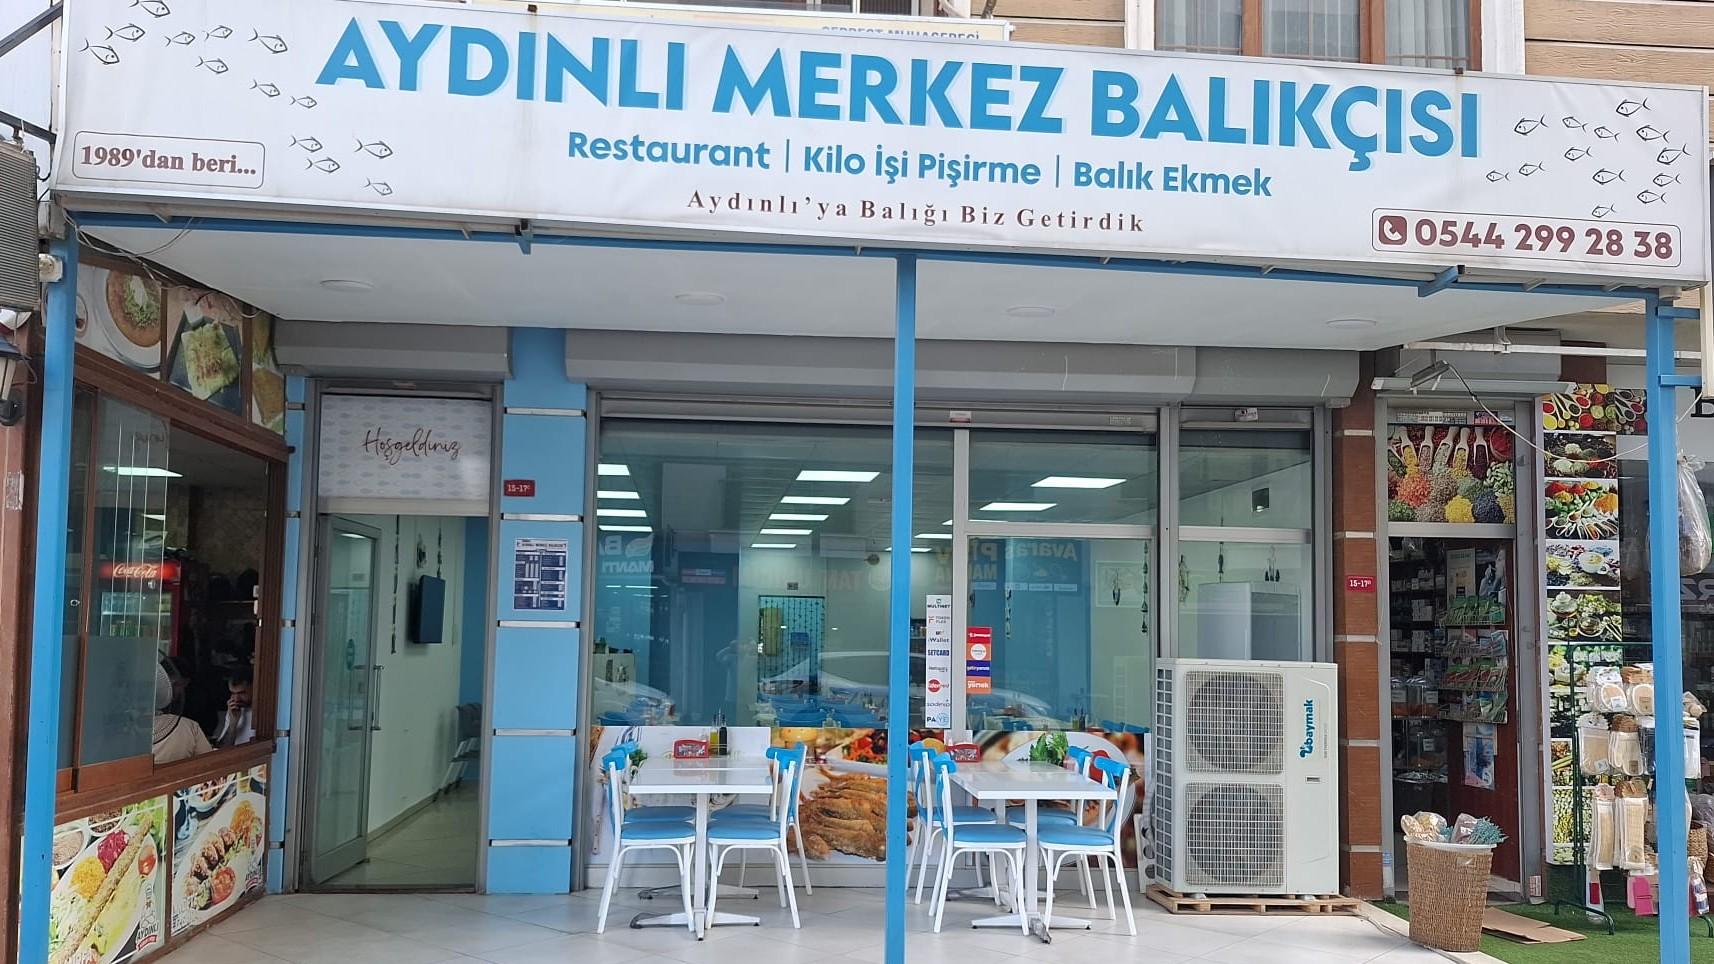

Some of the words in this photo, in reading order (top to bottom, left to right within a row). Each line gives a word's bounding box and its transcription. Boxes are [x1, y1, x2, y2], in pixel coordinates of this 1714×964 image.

[318, 20, 688, 111] AYDINLI
[713, 47, 1065, 135] MERKEZ
[1092, 70, 1479, 172] BALIKÇISI
[81, 145, 185, 171] 1989'dan
[192, 152, 257, 175] beri...
[568, 132, 770, 170] Restaurant
[803, 146, 866, 176] Kilo
[875, 151, 908, 183] İşi
[918, 153, 1041, 188] Pişirme
[1073, 161, 1153, 190] Balık
[1163, 164, 1272, 196] Ekmek
[860, 199, 950, 226] Balığı
[960, 205, 1005, 226] Biz
[1016, 208, 1144, 233] Getirdik
[1415, 218, 1505, 250] 0544
[1514, 223, 1576, 254] 299
[1584, 227, 1624, 257] 28
[1633, 230, 1673, 260] 38
[1303, 699, 1316, 746] baymak
